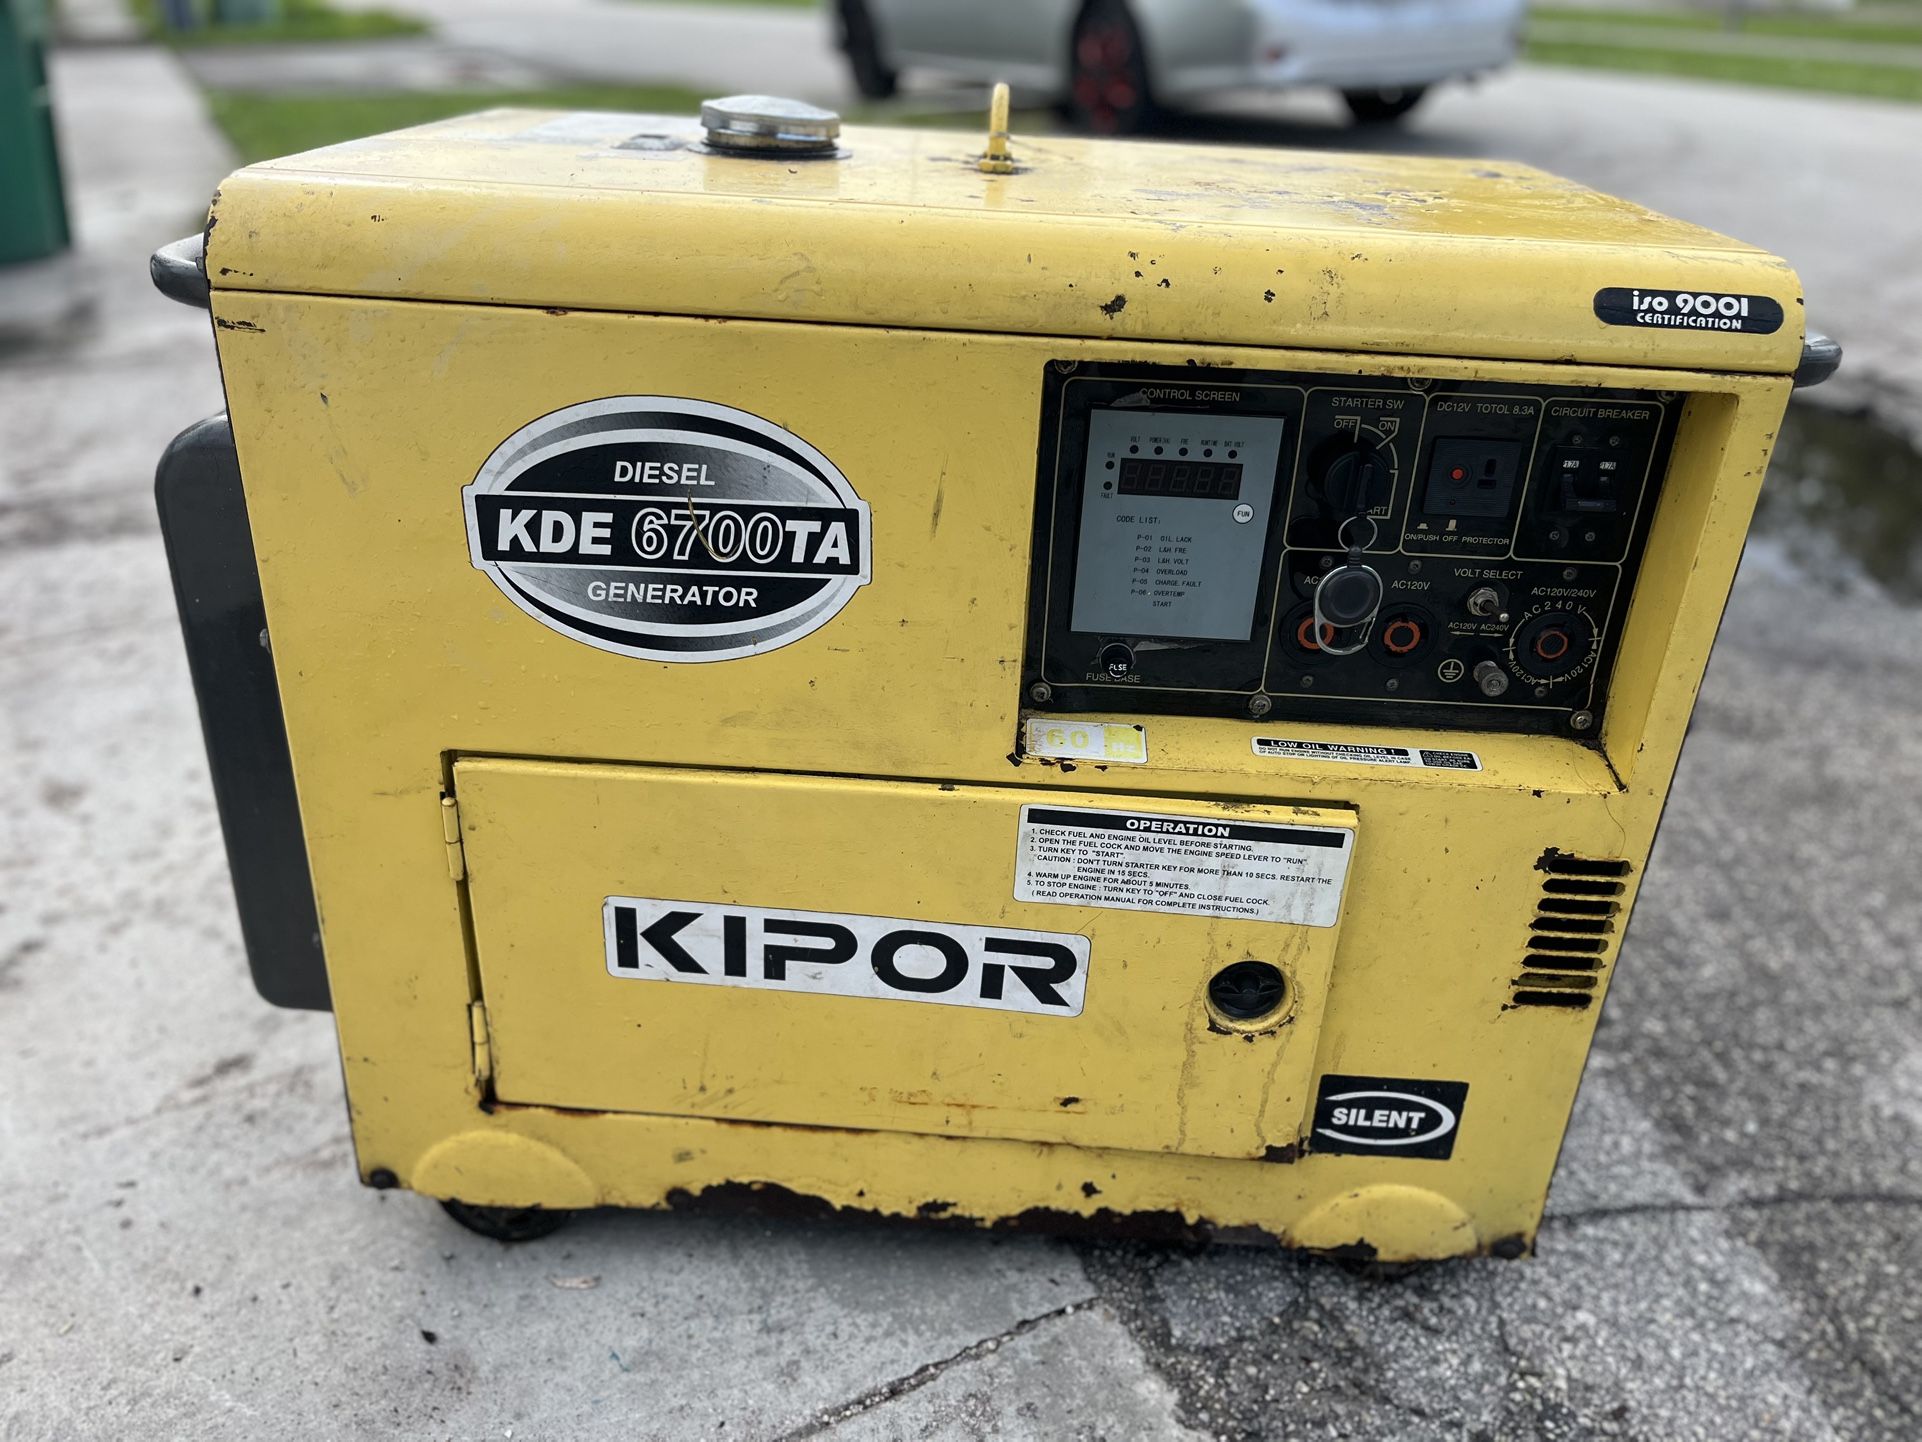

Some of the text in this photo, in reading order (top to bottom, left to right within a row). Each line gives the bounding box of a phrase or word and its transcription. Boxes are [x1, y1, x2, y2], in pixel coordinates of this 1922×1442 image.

[1675, 293, 1748, 316] 9001
[1636, 312, 1742, 330] CERTIFICATION
[1141, 388, 1240, 402] CONTROL SCREEN
[1331, 397, 1405, 410] STARTER SW
[1437, 401, 1535, 416] DC12V TOTOL 8.3A
[1551, 406, 1650, 420] CIRCUIT BREAKER
[1334, 419, 1356, 429] OFF
[1378, 421, 1395, 430] ON
[613, 461, 716, 486] DIESEL
[1116, 515, 1135, 523] CODE
[1237, 510, 1250, 518] FUN
[497, 507, 852, 565] KDE 6700TA
[1404, 533, 1439, 541] ON/PUSH
[1461, 536, 1510, 545] PROTECTOR
[1173, 558, 1189, 566] VOLT
[1454, 568, 1523, 580] VOLT SELECT
[1391, 580, 1430, 591] AC120V
[1530, 587, 1597, 598] AC120V/240V
[587, 581, 758, 608] GENERATOR
[1448, 621, 1510, 632] AC120V AC240V
[1086, 672, 1111, 682] FUSE
[1271, 740, 1298, 748] LOW
[1327, 745, 1387, 755] WARNING
[1126, 819, 1230, 837] OPERATION
[1040, 829, 1066, 837] CHECK
[1089, 832, 1106, 840] AND
[1108, 834, 1136, 842] ENGINE
[1139, 836, 1151, 844] OIL
[1153, 837, 1178, 846] LEVEL
[1180, 839, 1210, 848] BEFORE
[1213, 842, 1254, 851] STARTING.
[1038, 846, 1059, 854] TURN
[1060, 847, 1076, 855] KEY
[1039, 837, 1060, 845] OPEN
[1078, 840, 1098, 848] FUEL
[1100, 842, 1122, 850] COCK
[1142, 845, 1166, 853] MOVE
[1167, 847, 1182, 855] THE
[1184, 849, 1213, 857] ENGINE
[1215, 851, 1241, 859] SPEED
[1243, 854, 1269, 862] LEVER
[1037, 854, 1071, 863] CAUTION
[1077, 857, 1100, 865] DON'T
[1102, 859, 1123, 867] TURN
[1124, 861, 1160, 870] STARTER
[1179, 865, 1195, 873] FOR
[1197, 867, 1220, 875] MORE
[1222, 869, 1243, 877] THAN
[1245, 871, 1254, 879] 10
[1255, 872, 1278, 880] SECS.
[1280, 874, 1315, 883] RESTART
[1317, 877, 1333, 885] THE
[1077, 866, 1106, 875] ENGINE
[1127, 870, 1150, 878] SECS.
[1072, 874, 1101, 883] ENGINE
[1120, 878, 1147, 887] ABOUT
[1155, 881, 1191, 890] MINUTES.
[1068, 883, 1096, 891] ENGINE
[1103, 885, 1124, 893] TURN
[1155, 889, 1177, 897] "OFF"
[1179, 891, 1195, 899] AND
[1196, 893, 1222, 901] CLOSE
[1224, 895, 1244, 903] FUEL
[1058, 892, 1102, 901] OPERATION
[1104, 895, 1135, 904] MANUAL
[1155, 900, 1197, 909] COMPLETE
[1198, 903, 1259, 915] INSTRUCTIONS.)
[614, 906, 1078, 1007] KIPOR
[1331, 1107, 1426, 1130] SILENT
